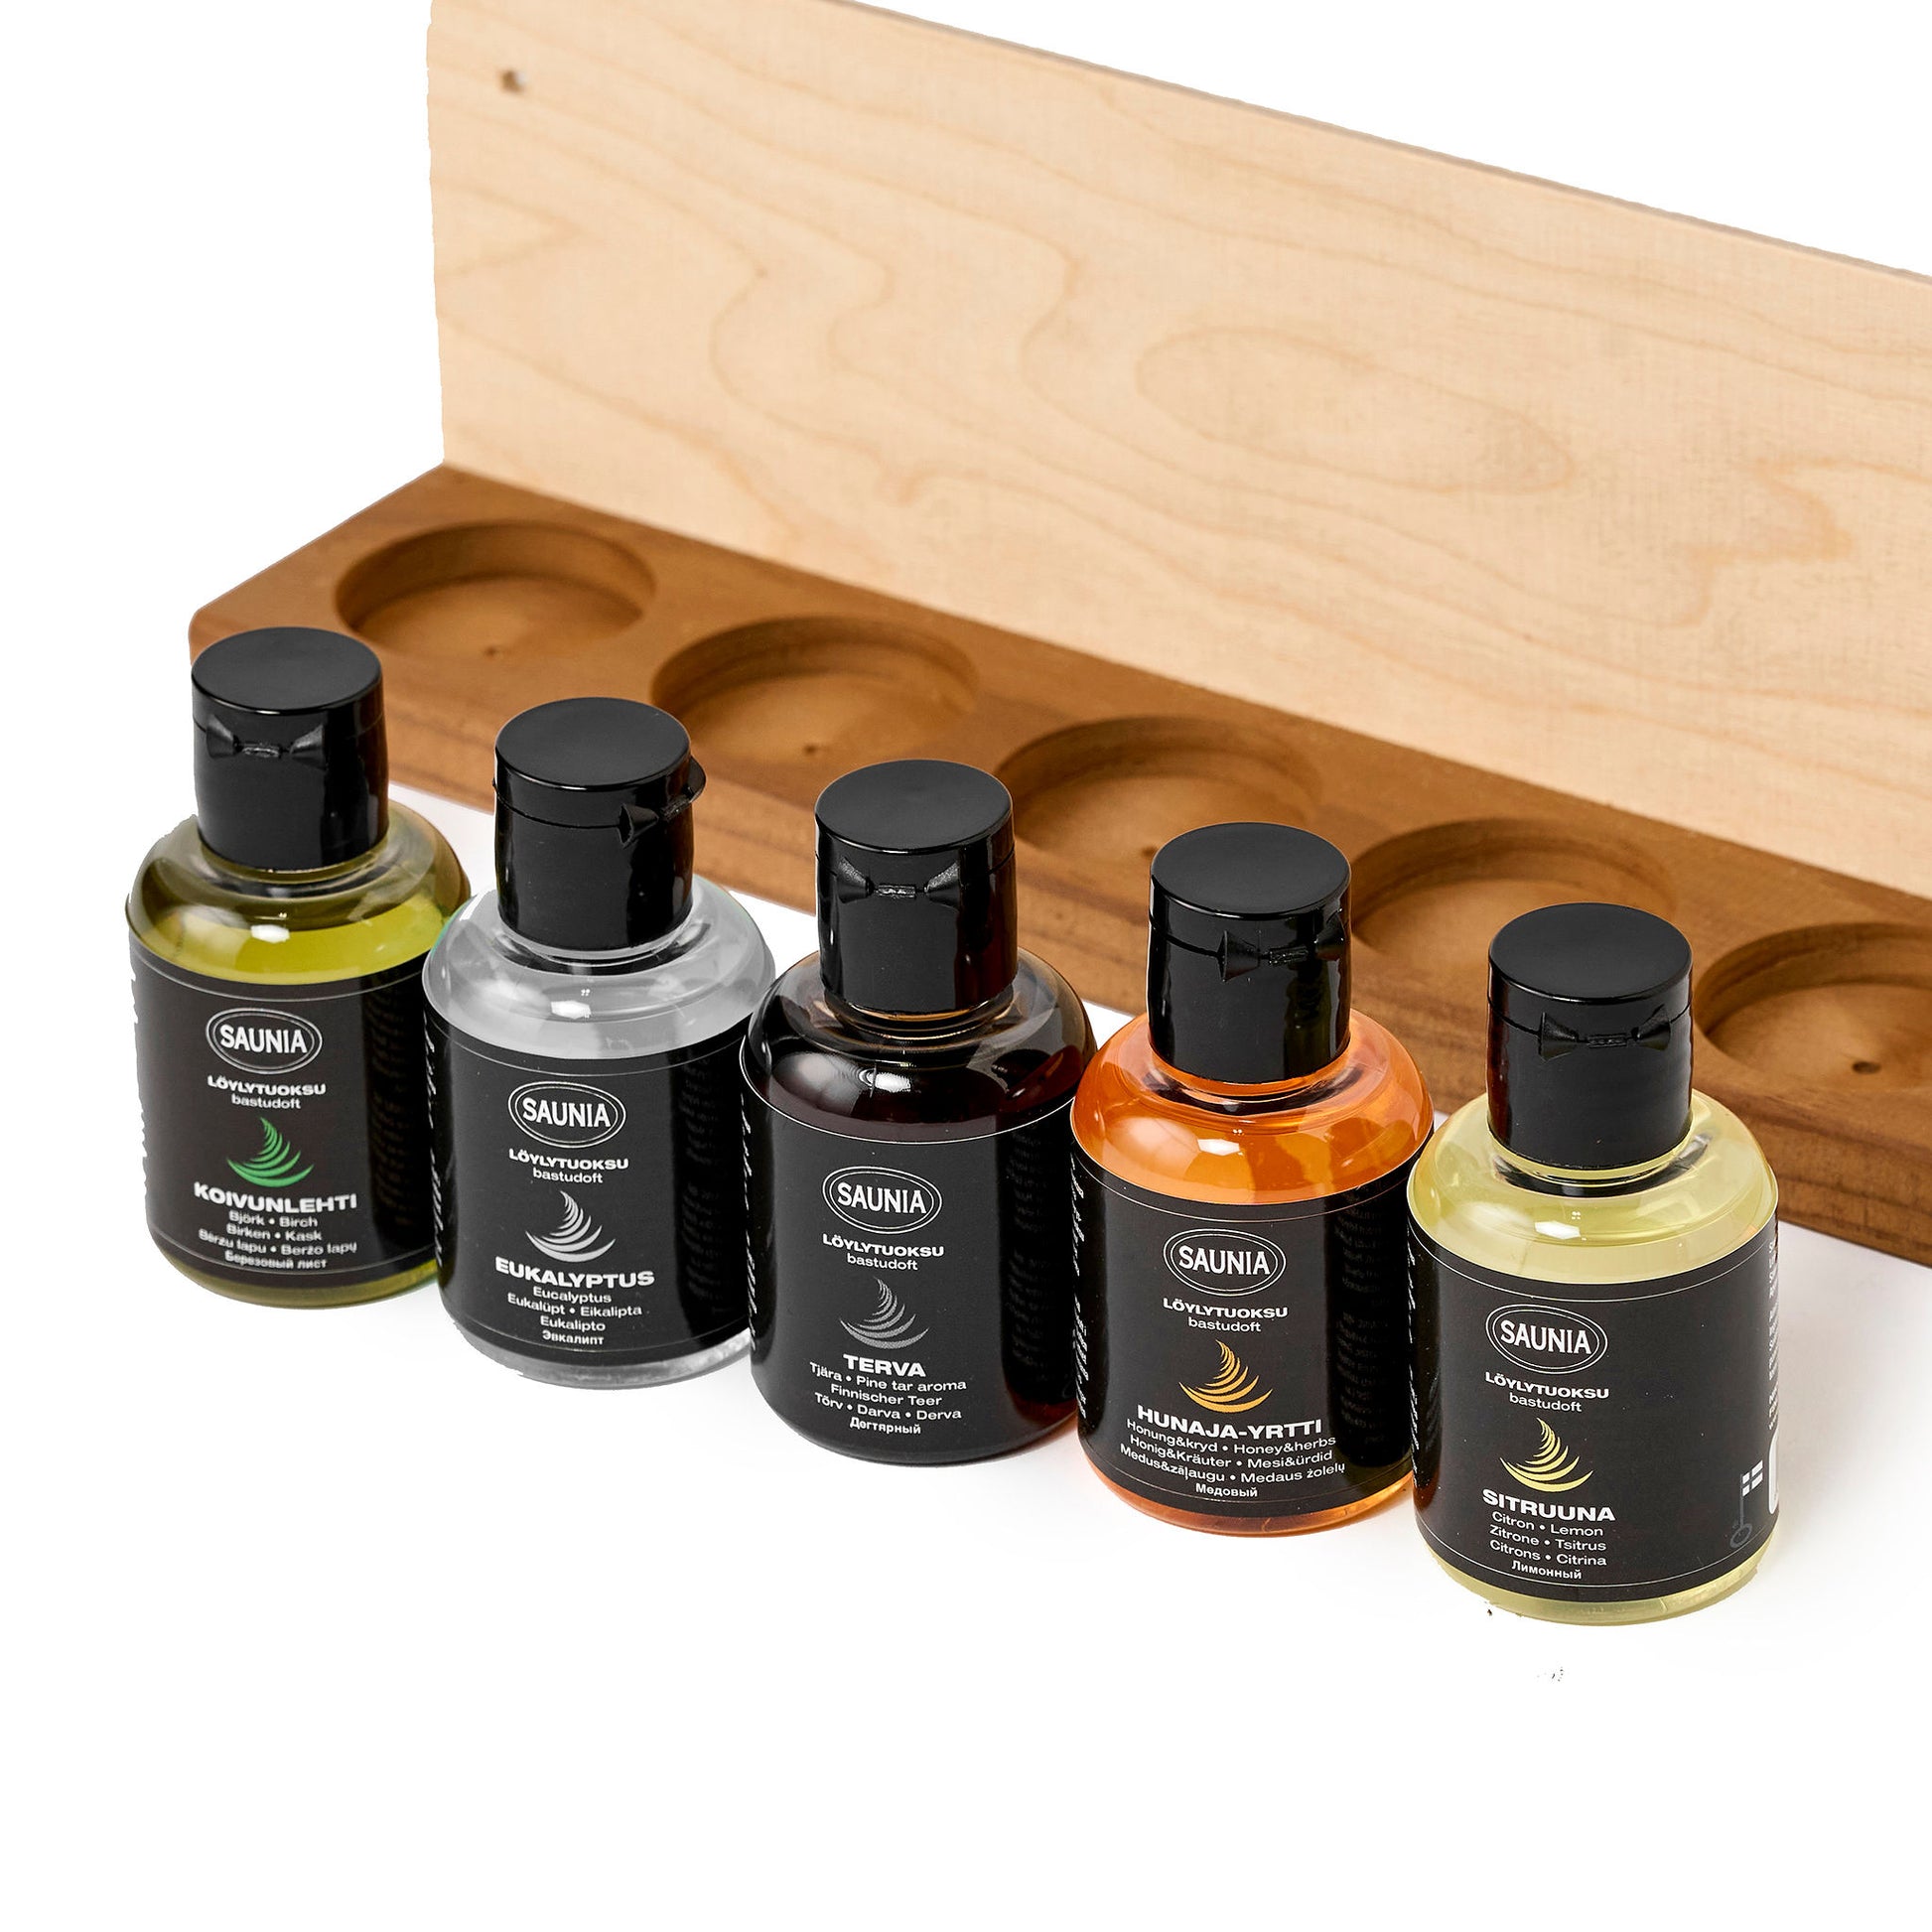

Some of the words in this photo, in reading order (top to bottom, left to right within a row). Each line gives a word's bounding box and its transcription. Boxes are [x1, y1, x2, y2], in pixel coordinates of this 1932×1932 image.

[220, 1024, 307, 1052] SAUNIA
[207, 1075, 326, 1095] LÖYLYTUOKSU
[231, 1093, 301, 1109] bastudoft
[522, 1097, 611, 1128] SAUNIA
[509, 1149, 628, 1170] LÖYLYTUOKSU
[533, 1168, 603, 1182] bastudoft
[194, 1181, 356, 1212] KOIVUNLEHTI
[838, 1182, 926, 1213] SAUNIA
[228, 1210, 265, 1226] Björk
[279, 1216, 318, 1227] Birch
[226, 1223, 270, 1240] Birken
[285, 1230, 322, 1241] Kask
[823, 1233, 944, 1257] LÖYLYTUOKSU
[298, 1259, 328, 1269] лист
[847, 1253, 917, 1270] bastudoft
[1178, 1245, 1270, 1275] SAUNIA
[495, 1256, 654, 1288] EUKALYPTUS
[507, 1293, 565, 1314] Eukalüpt
[581, 1307, 642, 1317] Eikalipta
[533, 1287, 612, 1304] Eucalyptus
[1164, 1298, 1288, 1318] LÖYLYTUOKSU
[540, 1315, 606, 1332] Eukalipto
[1188, 1316, 1261, 1331] bastudoft
[542, 1330, 604, 1344] Эвкалипт
[1500, 1319, 1591, 1354] SAUNIA
[843, 1353, 925, 1377] TERVA
[810, 1362, 842, 1381] Tjära
[857, 1375, 887, 1389] Pine
[893, 1381, 912, 1391] tar
[917, 1381, 966, 1391] aroma
[1485, 1372, 1608, 1399] LÖYLYTUOKSU
[831, 1384, 904, 1404] Finnischer
[908, 1395, 942, 1406] Teer
[1509, 1392, 1582, 1412] bastudoft
[858, 1405, 900, 1419] Darva
[916, 1410, 961, 1420] Derva
[1138, 1404, 1321, 1439] HUNAJA-YRTTI
[850, 1417, 920, 1434] Дегтярный
[1127, 1419, 1217, 1452] Honung&kryd
[1234, 1437, 1336, 1454] Honey&herbs
[1130, 1435, 1231, 1467] Honig&Kräuter
[1248, 1450, 1332, 1468] Mesi&ürdid
[1241, 1471, 1303, 1483] Medaus
[1195, 1483, 1257, 1497] Медовый
[1482, 1489, 1615, 1521] SITRUUNA
[1492, 1511, 1534, 1530] Citron
[1551, 1524, 1603, 1536] Lemon
[1490, 1524, 1539, 1545] Zitrone
[1555, 1539, 1606, 1551] Tsitrus
[1490, 1540, 1541, 1561] Citrons
[1557, 1554, 1606, 1566] Citrina
[1512, 1561, 1582, 1579] Лимонный
